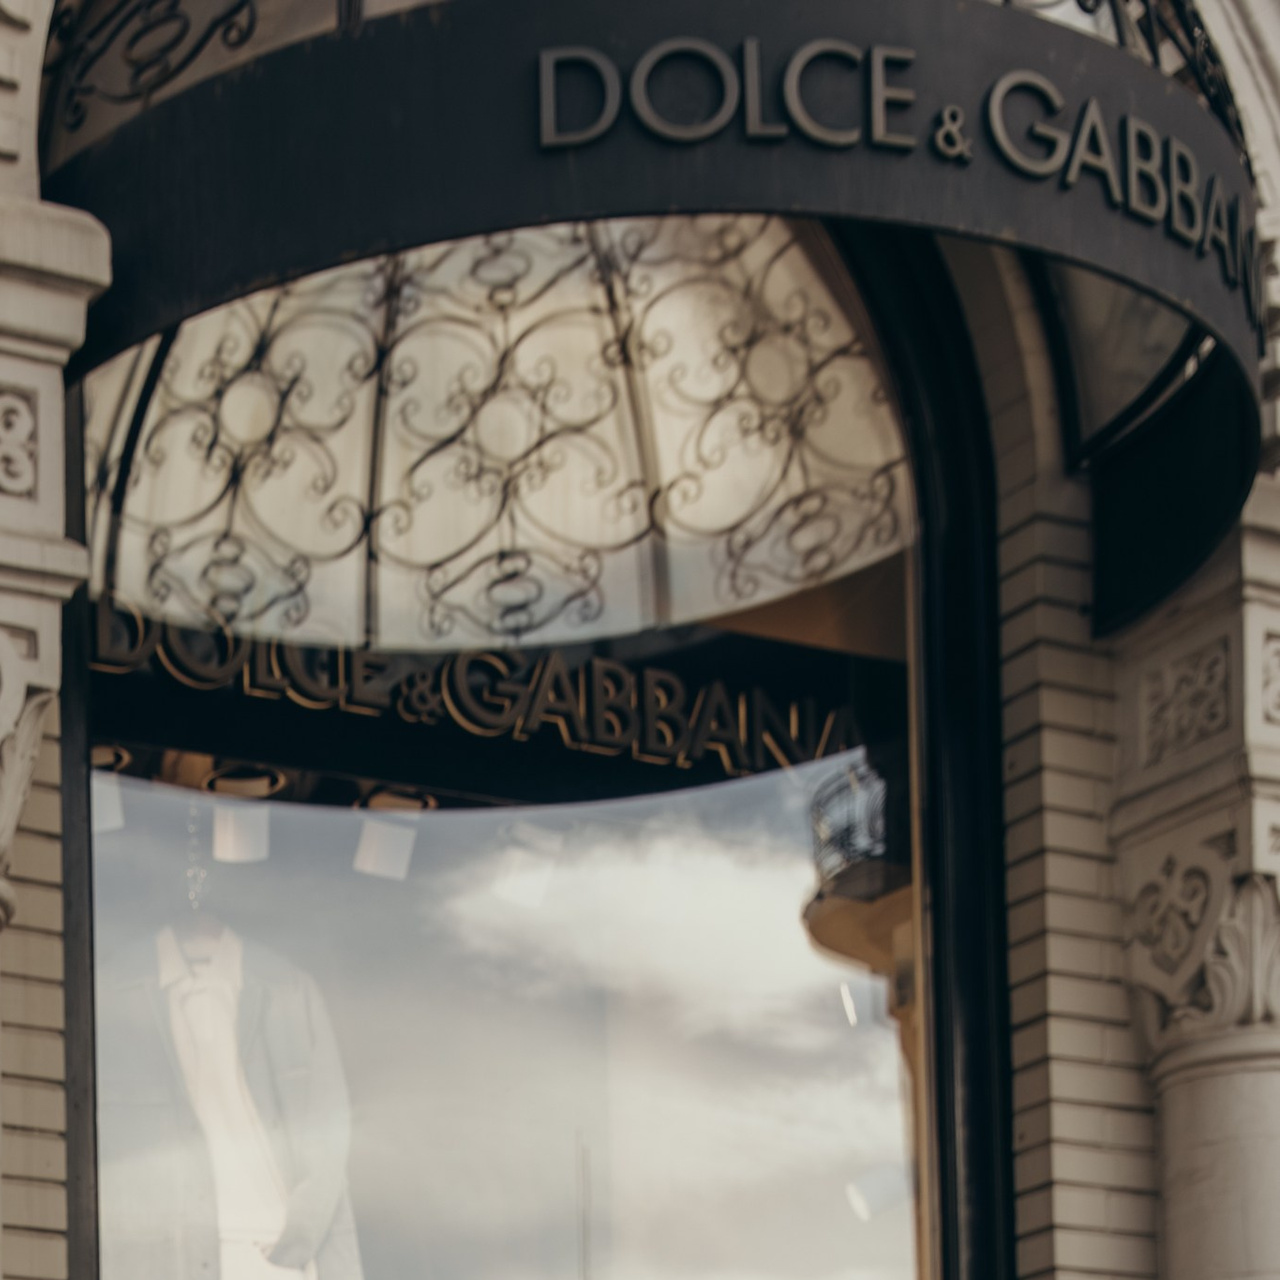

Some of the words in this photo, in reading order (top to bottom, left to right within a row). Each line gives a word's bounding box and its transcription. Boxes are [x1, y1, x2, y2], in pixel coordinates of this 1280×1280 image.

[539, 37, 916, 148] DOLCE
[934, 105, 973, 160] &
[397, 666, 444, 726] &
